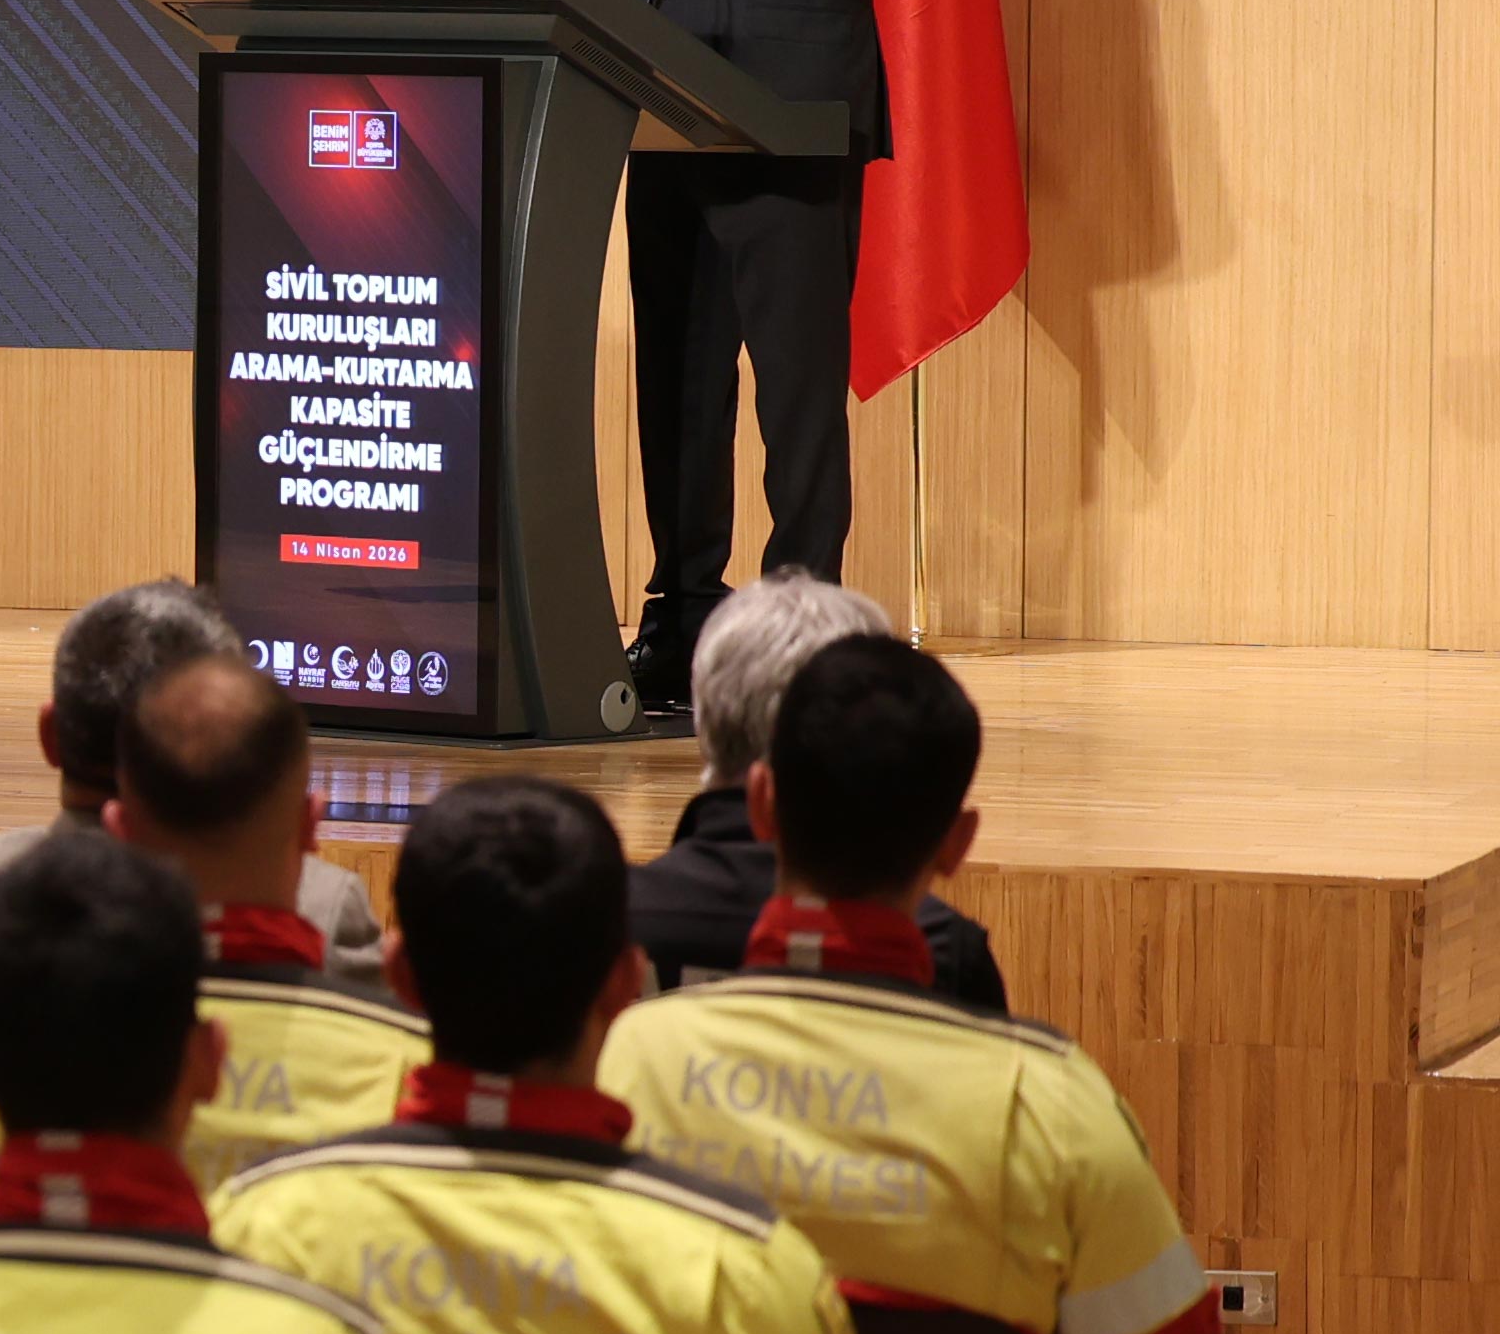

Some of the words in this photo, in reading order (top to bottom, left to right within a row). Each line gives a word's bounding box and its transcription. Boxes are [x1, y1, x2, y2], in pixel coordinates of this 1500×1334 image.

[265, 263, 329, 301] SİVİL
[332, 273, 438, 305] TOPLUM
[266, 312, 436, 352] KURULUŞLARI
[229, 352, 474, 390] ARAMA-KURTARMA
[290, 391, 412, 429] KAPASİTE
[258, 429, 443, 473] GÜÇLENDİRME
[279, 477, 420, 512] PROGRAMI
[291, 541, 308, 556] 14
[316, 543, 361, 559] Nisan
[367, 546, 407, 562] 2026
[680, 1055, 888, 1127] KONYA
[358, 1239, 588, 1319] KONYA
